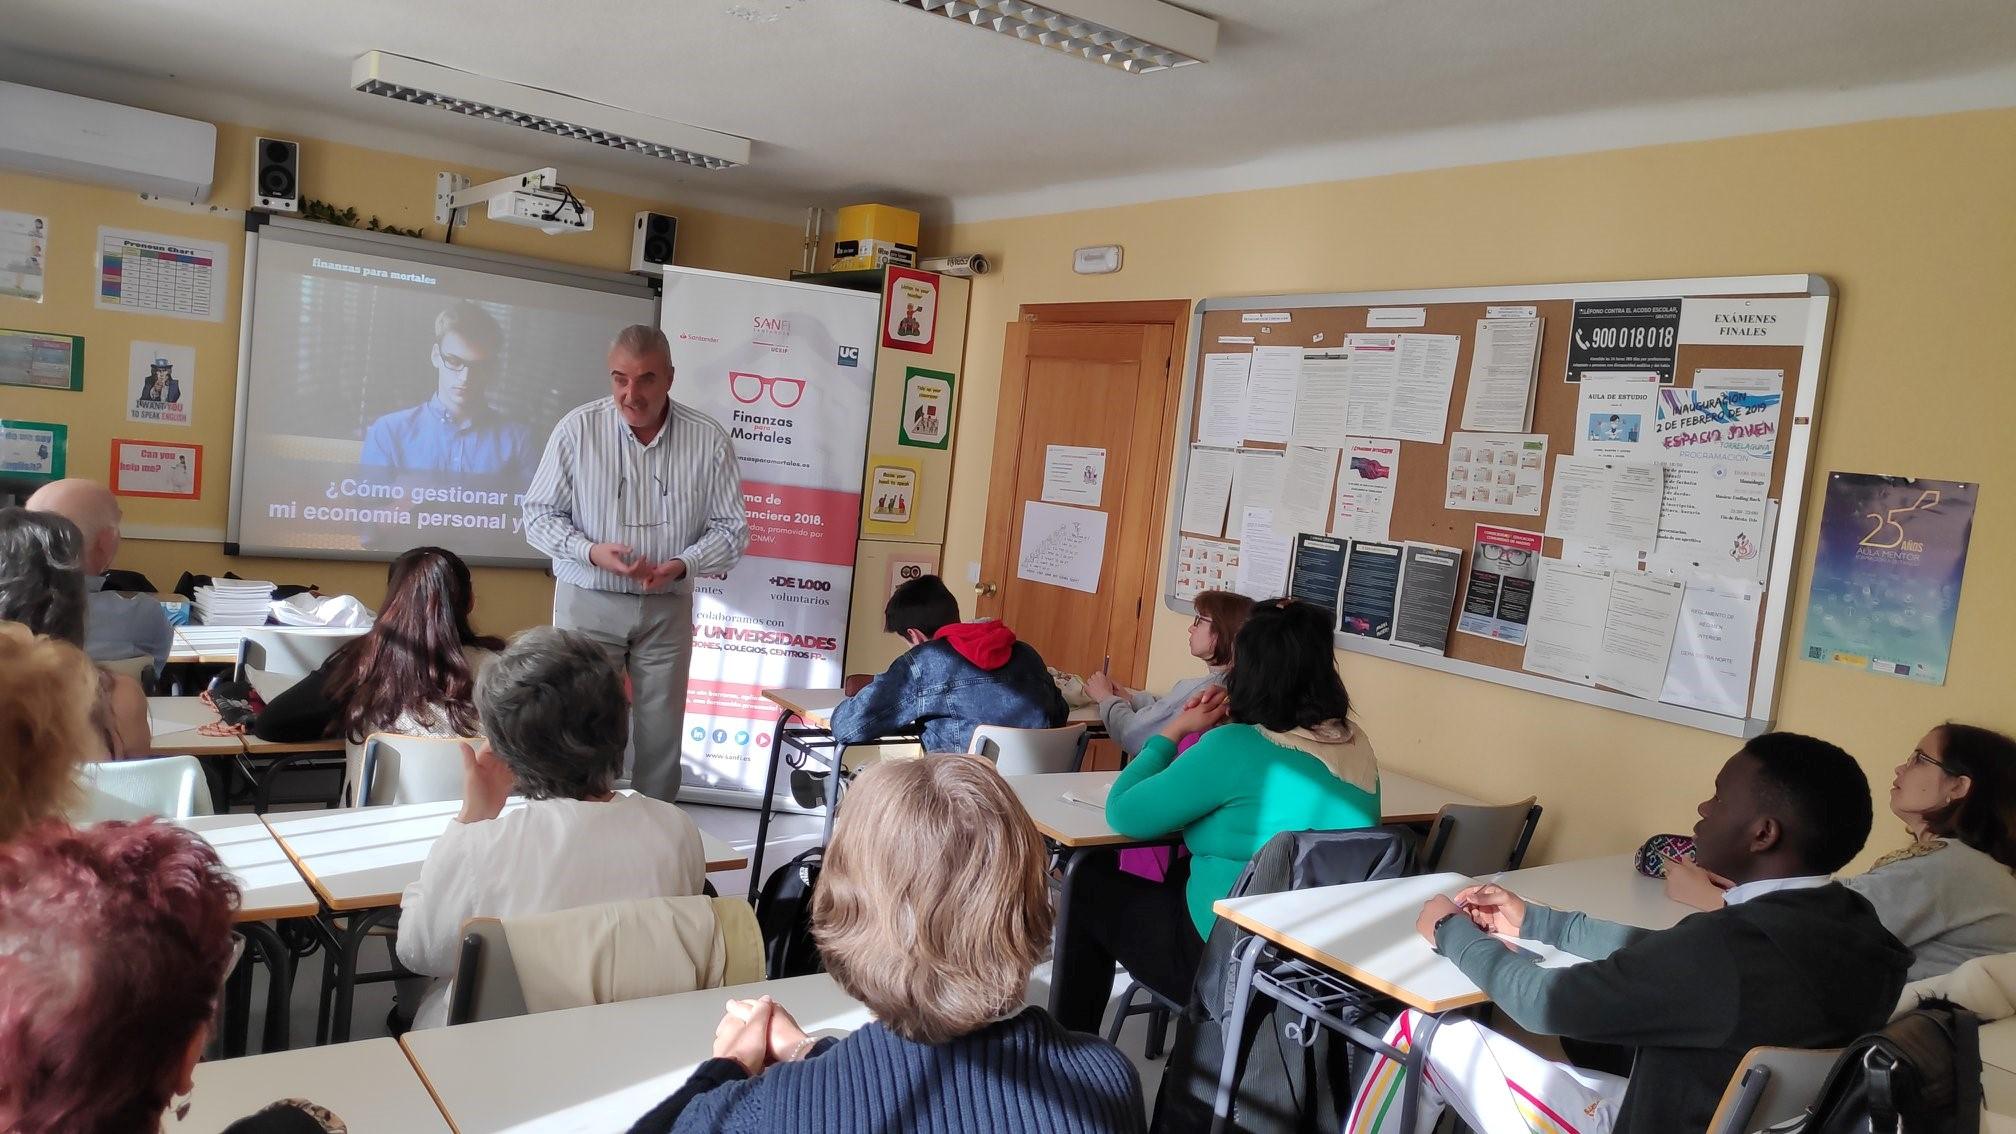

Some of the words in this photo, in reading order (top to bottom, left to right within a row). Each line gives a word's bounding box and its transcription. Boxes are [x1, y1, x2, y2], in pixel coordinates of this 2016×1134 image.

[124, 240, 165, 251] Pronoun
[168, 246, 194, 256] Chart
[312, 257, 361, 274] finanzas
[362, 267, 388, 277] para
[390, 273, 437, 285] mortales
[1714, 311, 1777, 324] EXÁMENES
[1592, 327, 1617, 348] 900
[1618, 326, 1645, 348] 018
[1647, 326, 1674, 348] 018
[1719, 326, 1768, 336] FINALES
[839, 347, 859, 360] UC
[167, 402, 183, 412] YOU
[141, 411, 161, 420] SPEAK
[733, 409, 793, 428] Finanzas
[1656, 423, 1663, 433] 2
[1665, 421, 1678, 431] DE
[1680, 411, 1726, 428] FEBRERO
[1728, 408, 1741, 418] DE
[1745, 402, 1767, 415] 2019
[730, 426, 792, 445] Mortales
[754, 424, 771, 432] para
[1663, 430, 1721, 449] ESPACIO
[1727, 421, 1775, 440] JOVEN
[140, 449, 158, 459] Can
[160, 451, 176, 460] you
[141, 464, 161, 473] me?
[325, 479, 404, 500] ¿Cómo
[411, 484, 508, 505] gestionar
[765, 494, 782, 505] de
[269, 501, 296, 519] mi
[303, 503, 411, 525] economía
[417, 511, 506, 530] personal
[512, 517, 523, 534] y
[745, 510, 791, 522] anciera
[794, 513, 825, 527] 2018.
[768, 526, 808, 537] promovido
[809, 531, 824, 539] por
[1901, 539, 1924, 552] AÑOS
[1856, 547, 1880, 557] AULA
[1882, 549, 1921, 562] MENTOR
[694, 585, 724, 596] antes
[770, 592, 830, 606] voluntarios
[696, 611, 765, 626] colaboramos
[765, 619, 785, 628] con
[704, 625, 837, 651] UNIVERSIDADES
[723, 643, 768, 656] COLEGIOS,
[769, 648, 810, 659] CENTROS
